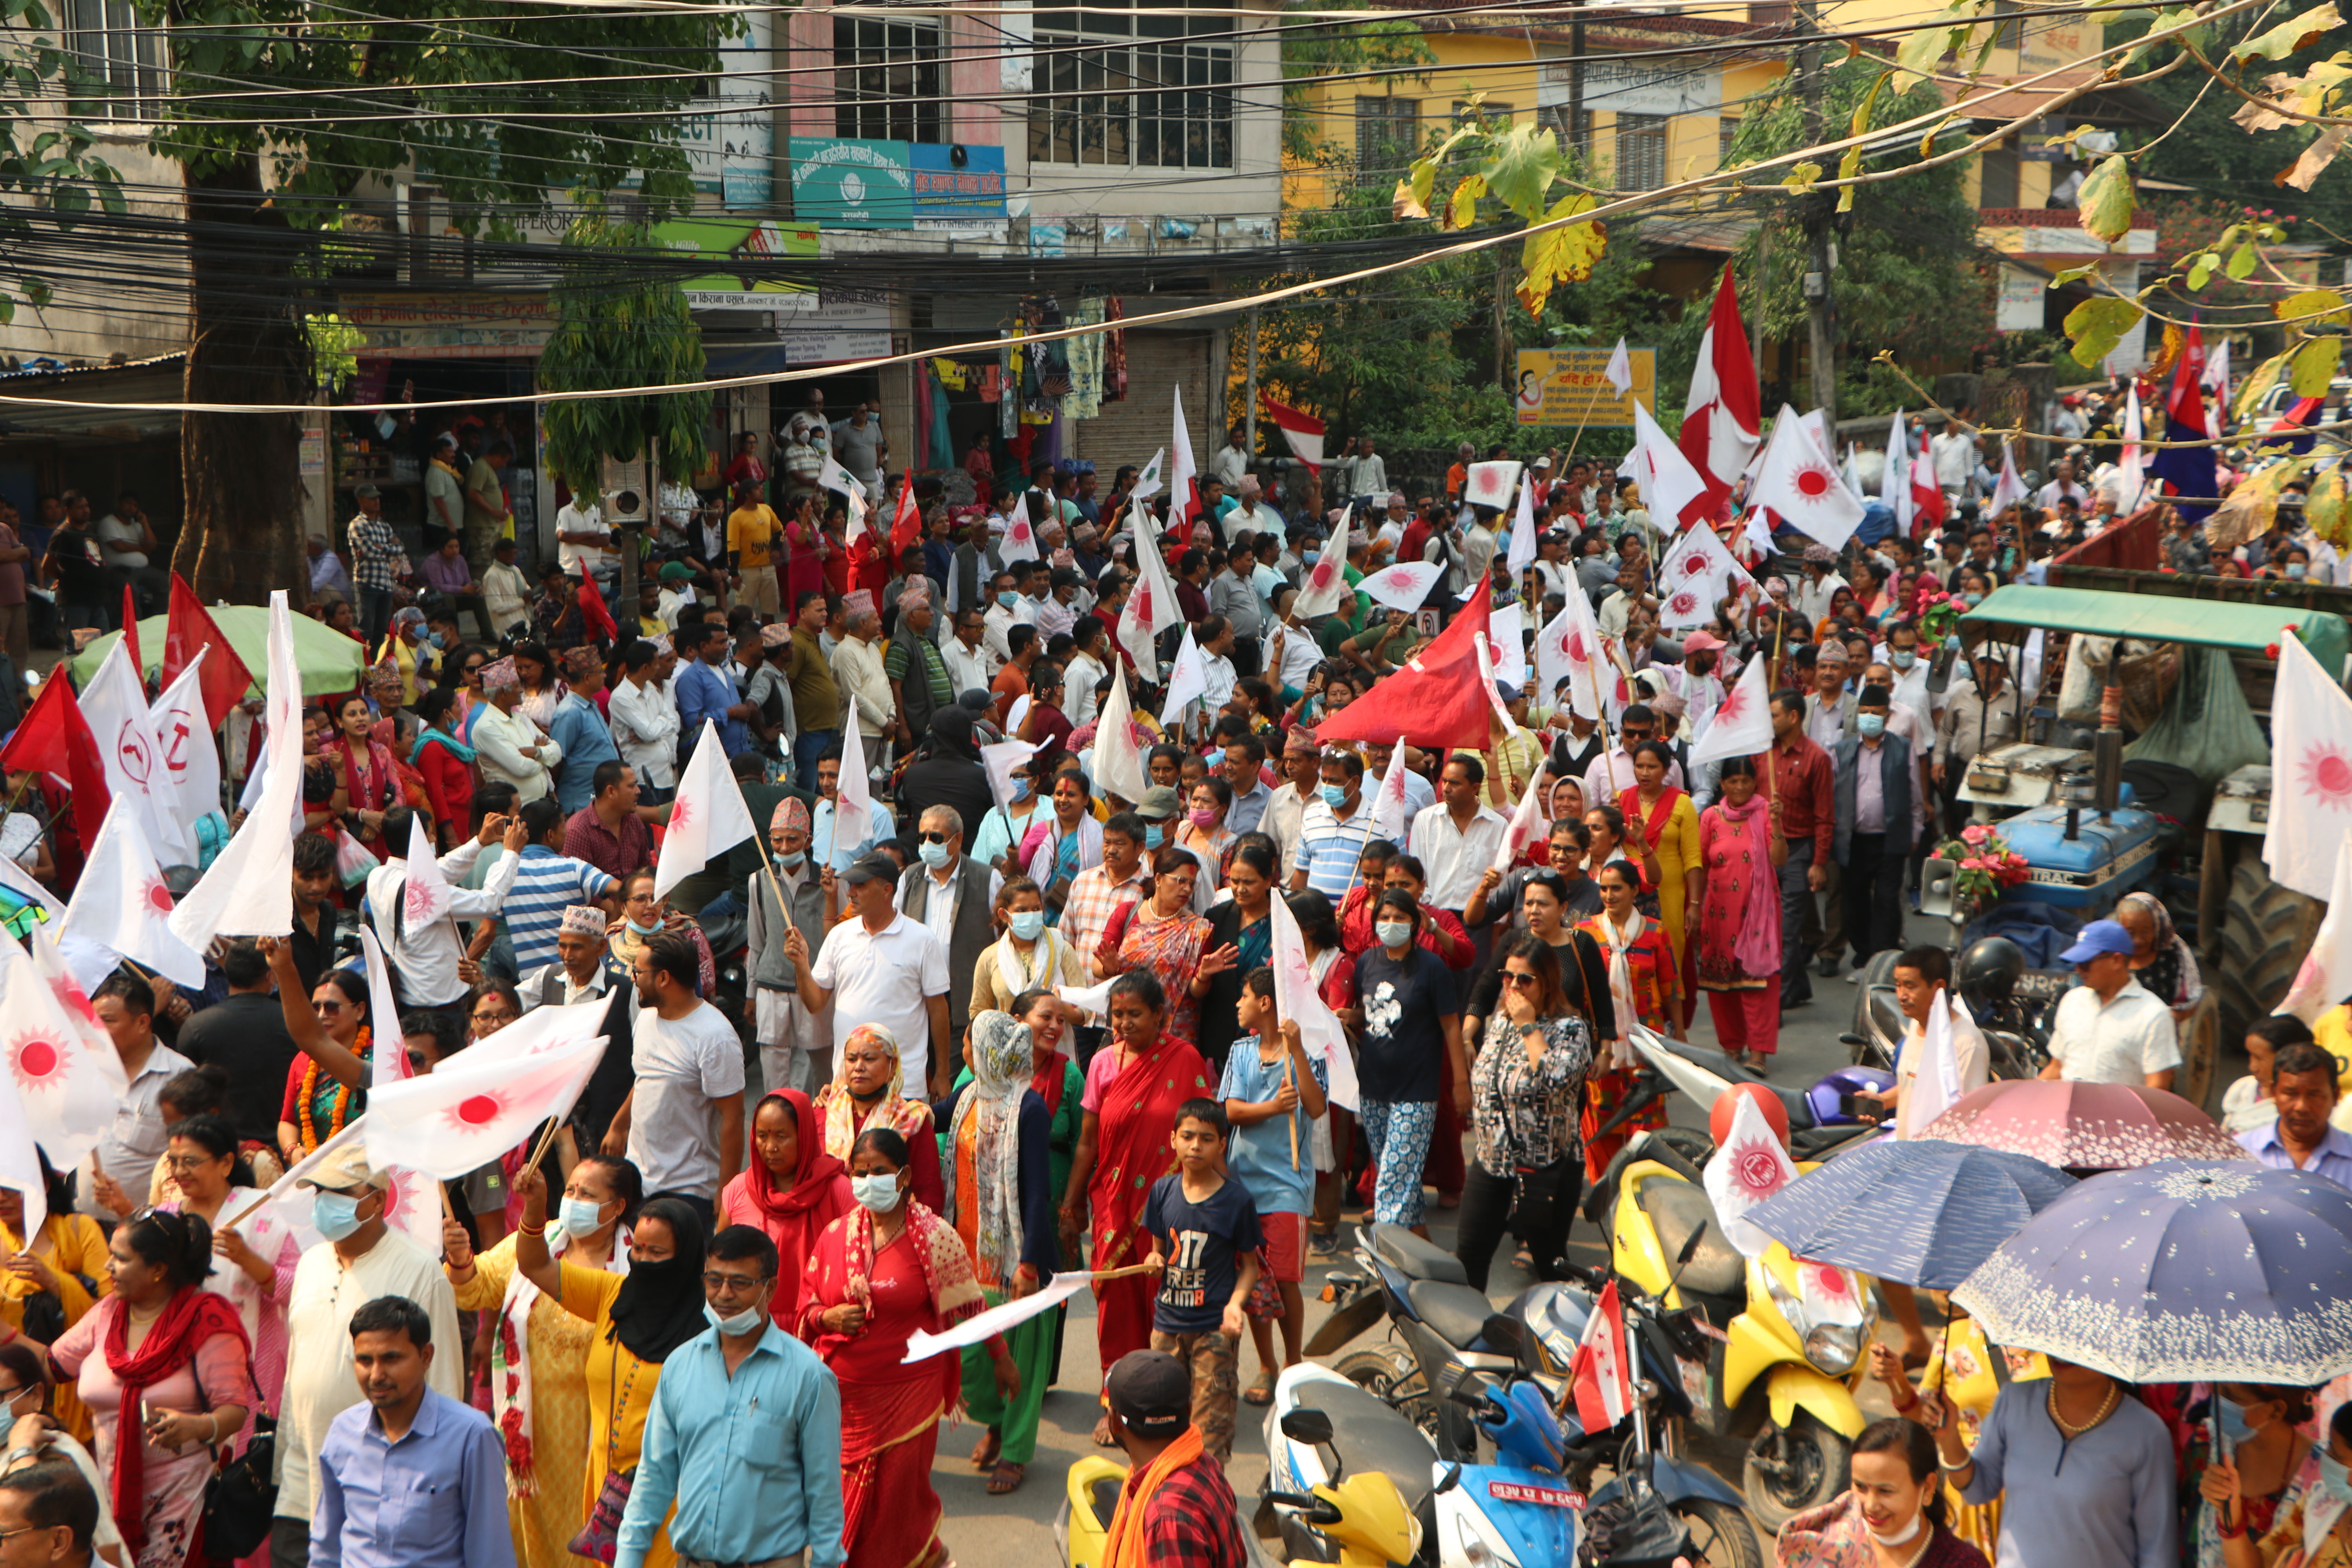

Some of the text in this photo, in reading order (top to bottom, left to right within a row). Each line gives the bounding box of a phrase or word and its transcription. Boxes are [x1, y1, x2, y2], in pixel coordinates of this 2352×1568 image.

[851, 145, 872, 164] सहकारी
[956, 170, 978, 194] नेपाल
[916, 197, 948, 205] Collection
[949, 197, 974, 206] Counter
[676, 240, 701, 250] Hilife
[699, 292, 724, 304] किराना
[726, 294, 744, 304] पसल
[1549, 351, 1555, 360] के
[1573, 351, 1591, 363] सुरक्षित
[1572, 364, 1590, 374] आउनु
[1559, 372, 1580, 384] यदि
[1583, 374, 1594, 386] हो
[2031, 871, 2074, 885] TRAC
